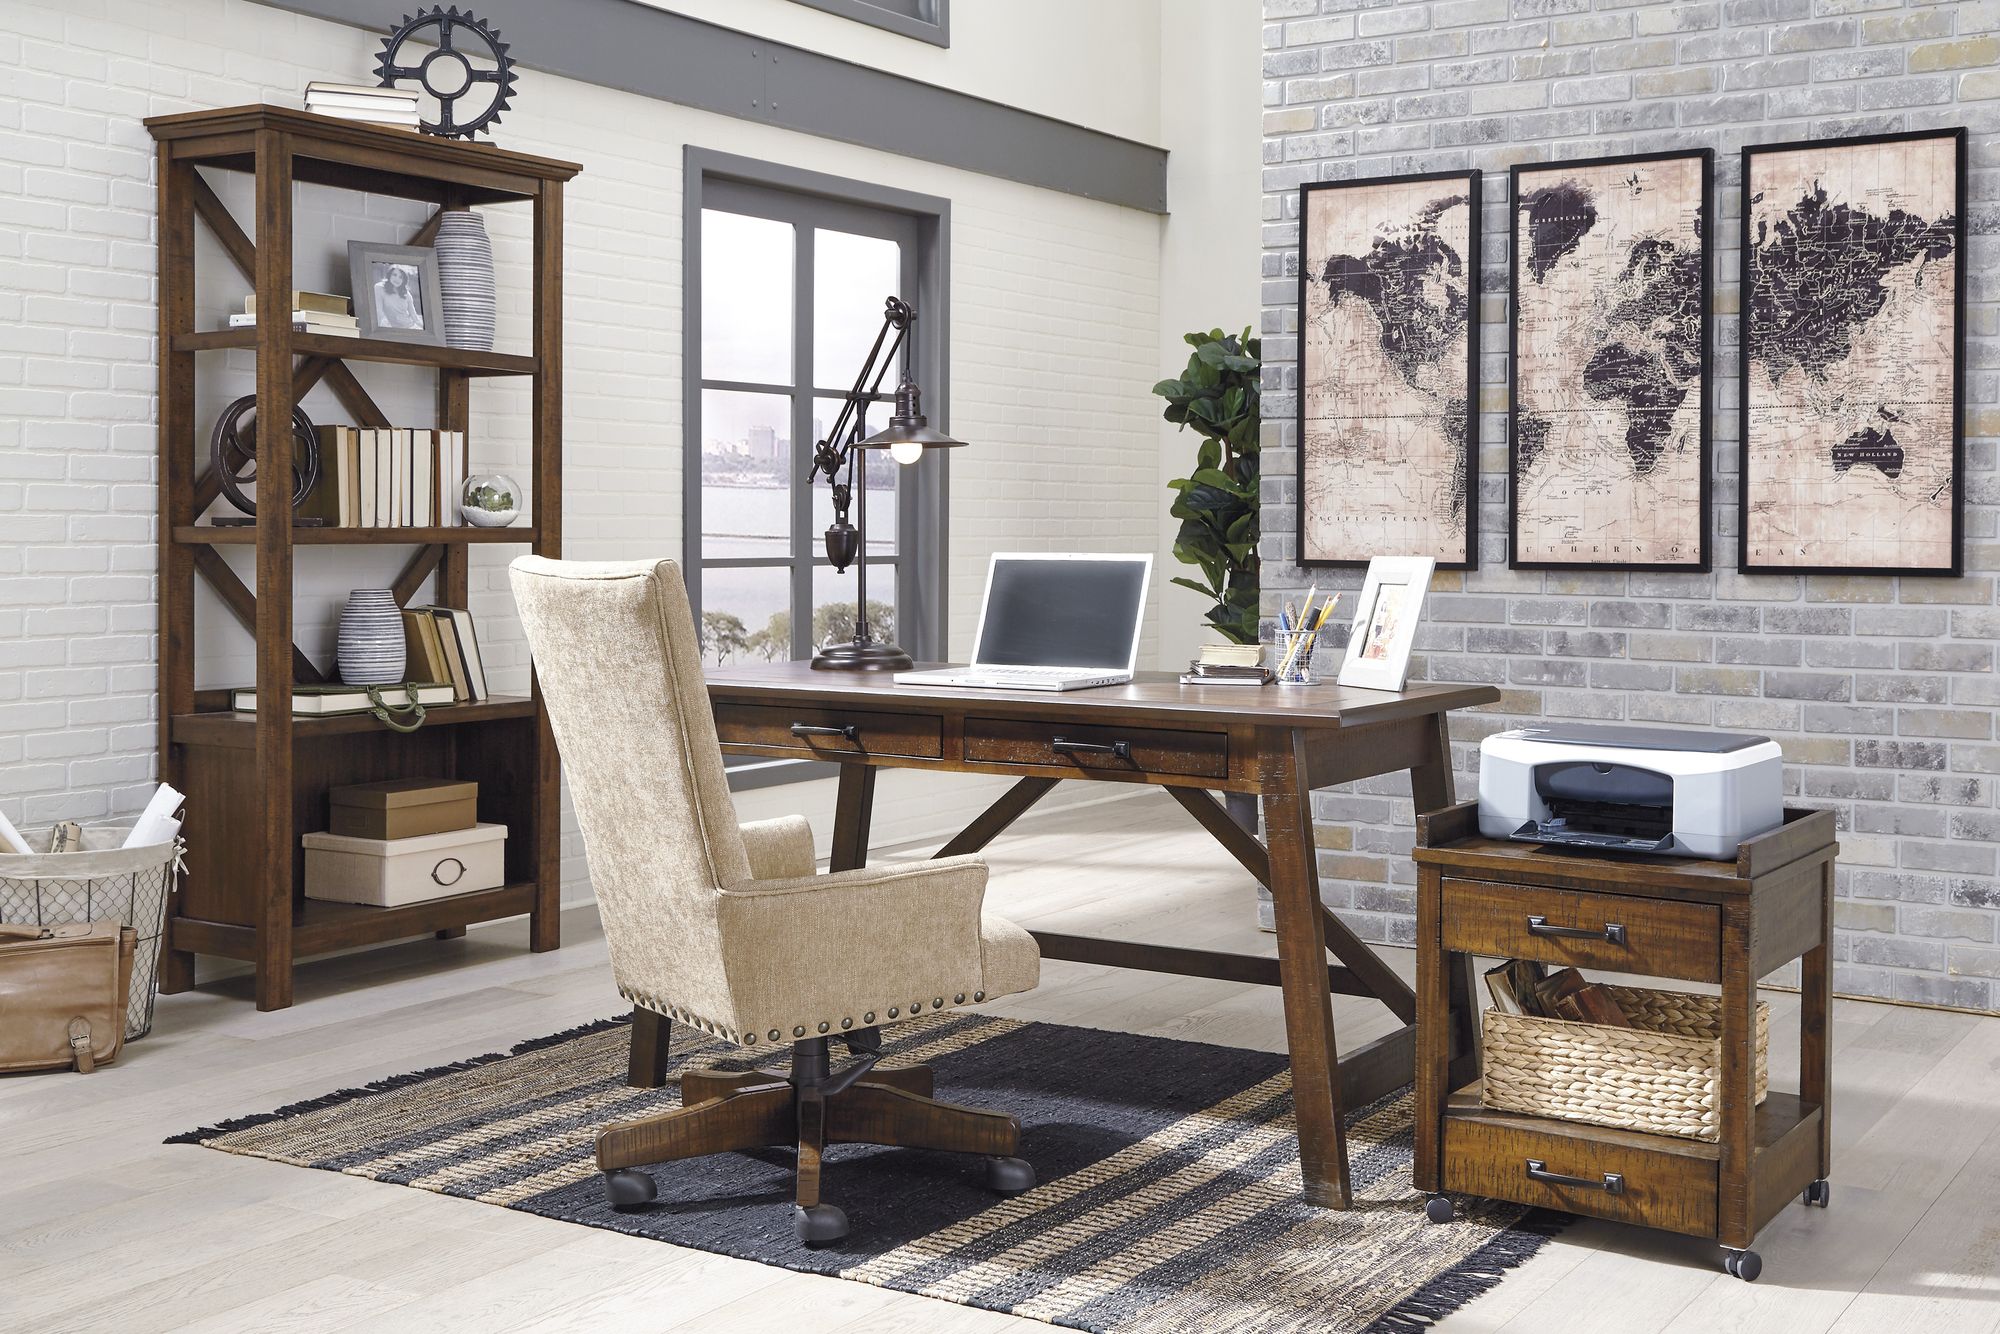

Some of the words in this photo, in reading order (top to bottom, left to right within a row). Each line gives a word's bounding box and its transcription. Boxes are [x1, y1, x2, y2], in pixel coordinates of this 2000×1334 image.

[1534, 214, 1588, 224] GREENLAND
[1537, 315, 1580, 323] ATLANTIC
[1307, 391, 1355, 399] PACIFIC
[1561, 489, 1612, 497] OCEAN
